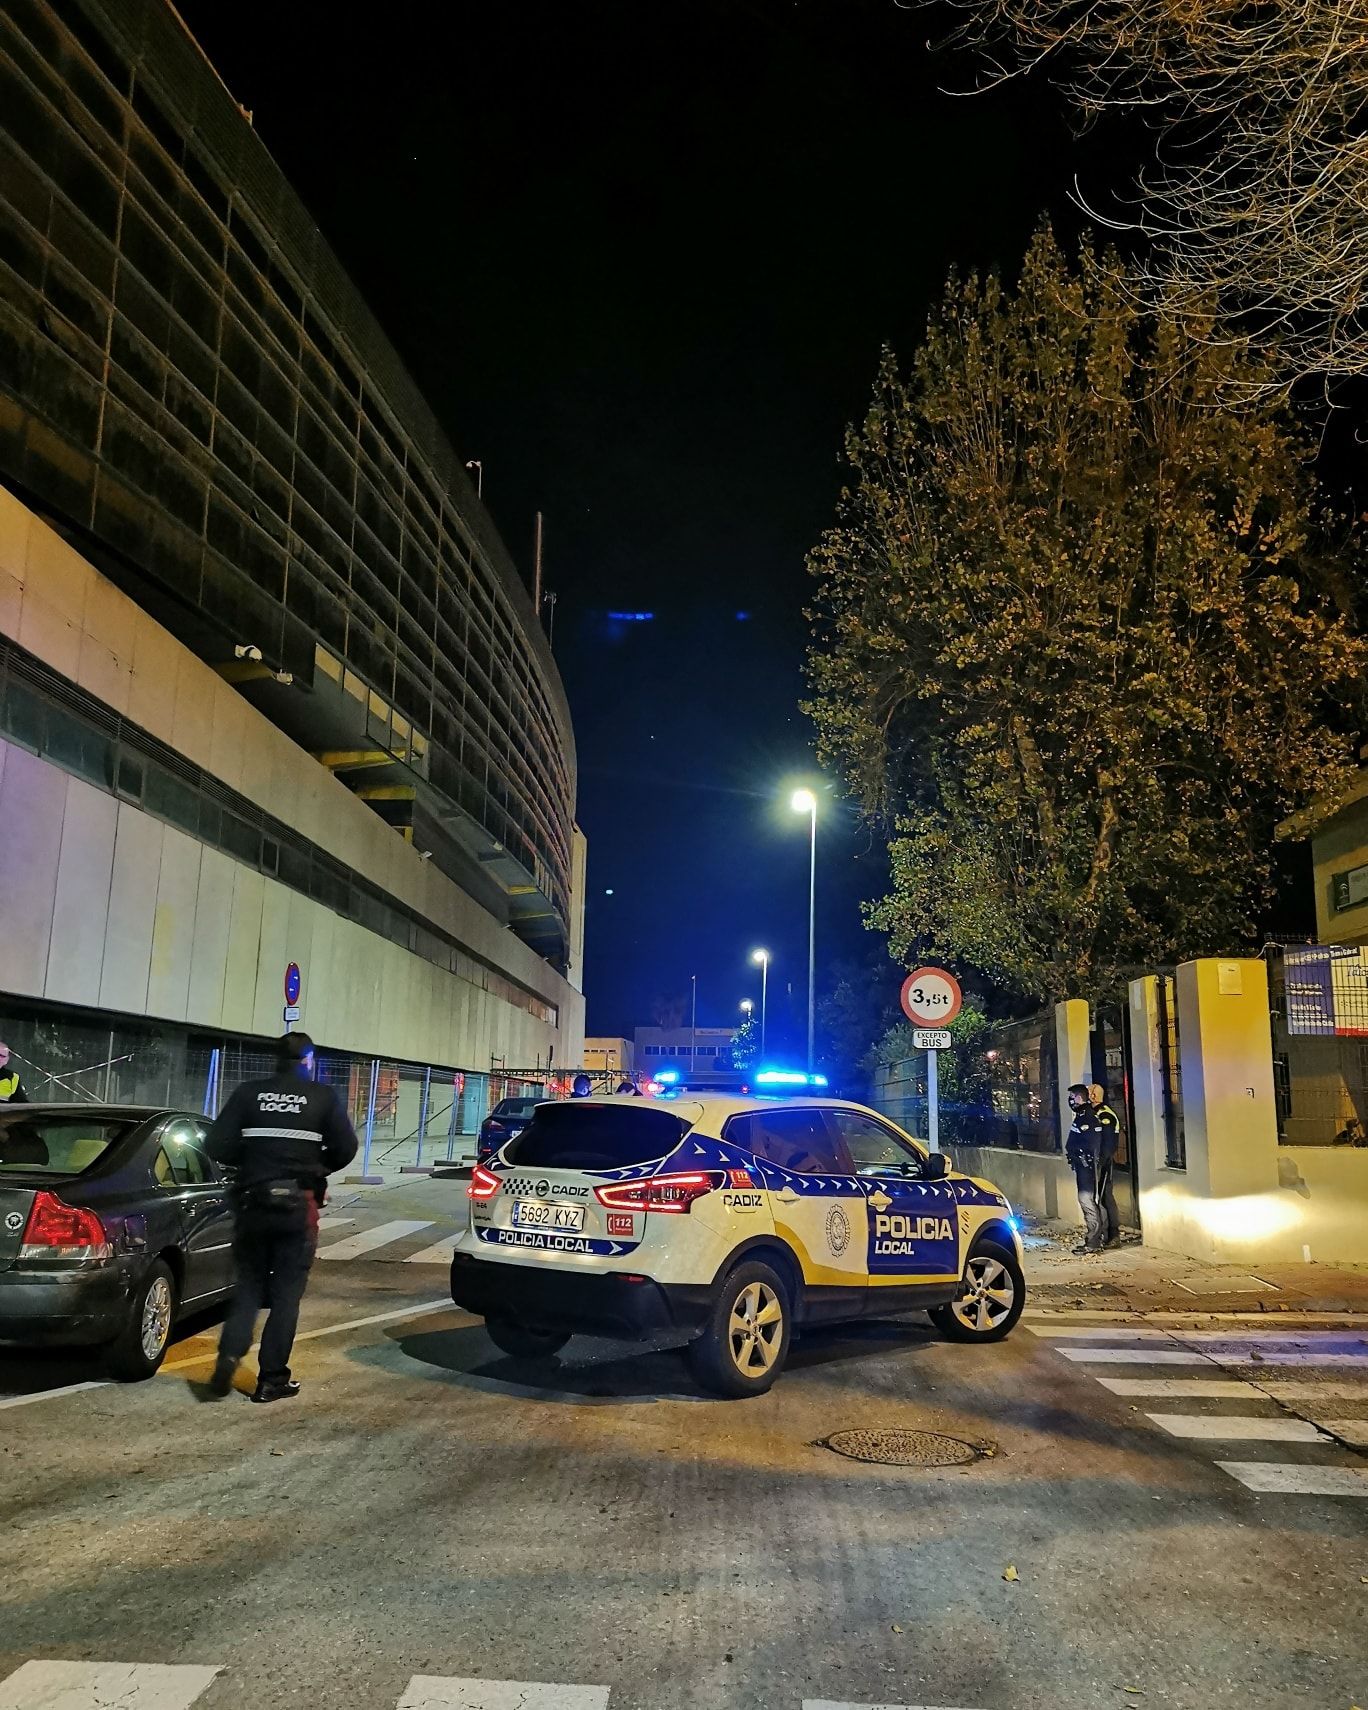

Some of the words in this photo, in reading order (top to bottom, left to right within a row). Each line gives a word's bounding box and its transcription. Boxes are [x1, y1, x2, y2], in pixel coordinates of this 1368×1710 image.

[912, 988, 948, 1006] 3,5t
[921, 1038, 942, 1047] BUS
[257, 1092, 307, 1104] POLICIA
[260, 1102, 301, 1113] LOCAL
[735, 1171, 748, 1179] 112
[551, 1184, 589, 1197] CADIZ
[723, 1195, 762, 1207] CADIZ
[520, 1205, 550, 1224] 5692
[554, 1208, 578, 1227] KYZ
[615, 1217, 632, 1227] 112
[875, 1214, 954, 1240] POLICIA
[498, 1231, 544, 1247] POLICIA
[547, 1238, 593, 1253] LOCAL
[874, 1241, 915, 1255] LOCAL
